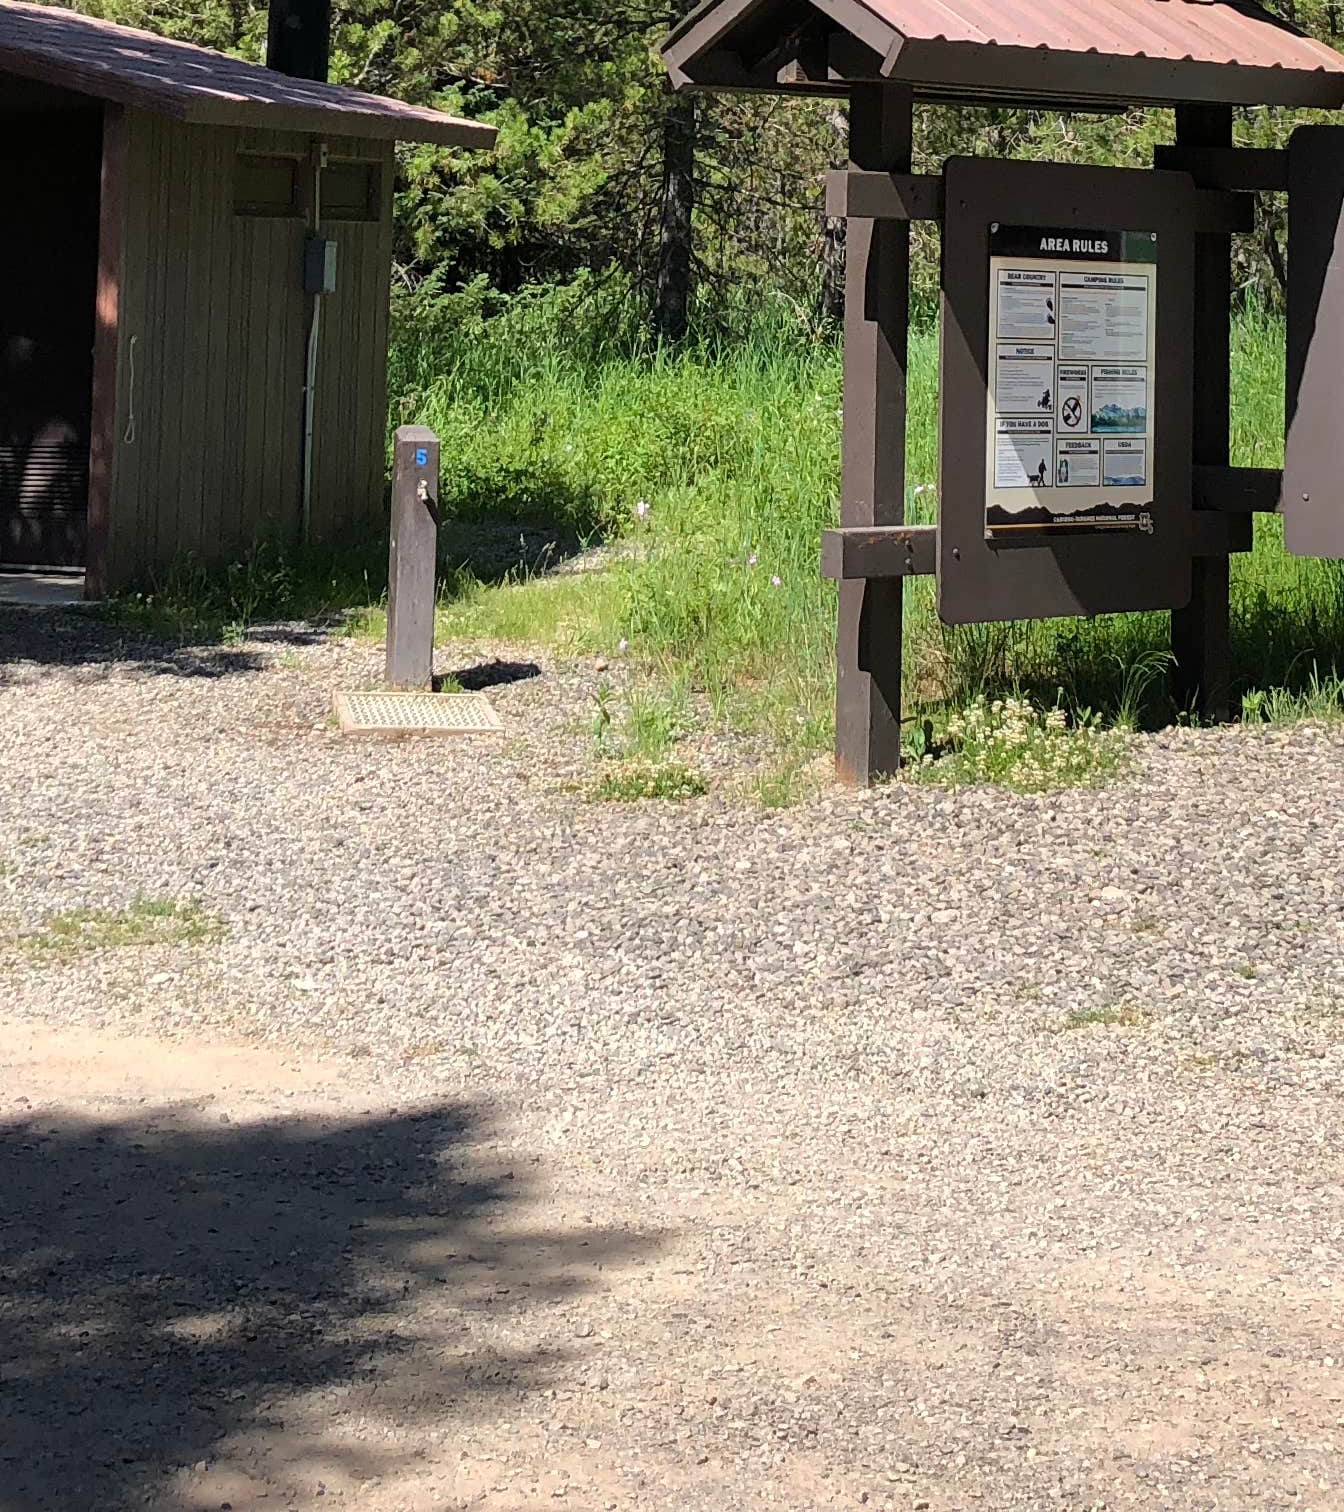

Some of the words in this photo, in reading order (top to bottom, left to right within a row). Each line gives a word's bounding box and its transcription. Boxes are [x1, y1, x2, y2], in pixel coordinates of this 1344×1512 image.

[1040, 238, 1070, 251] AREA
[1073, 240, 1108, 253] RULES
[416, 448, 428, 465] 5
